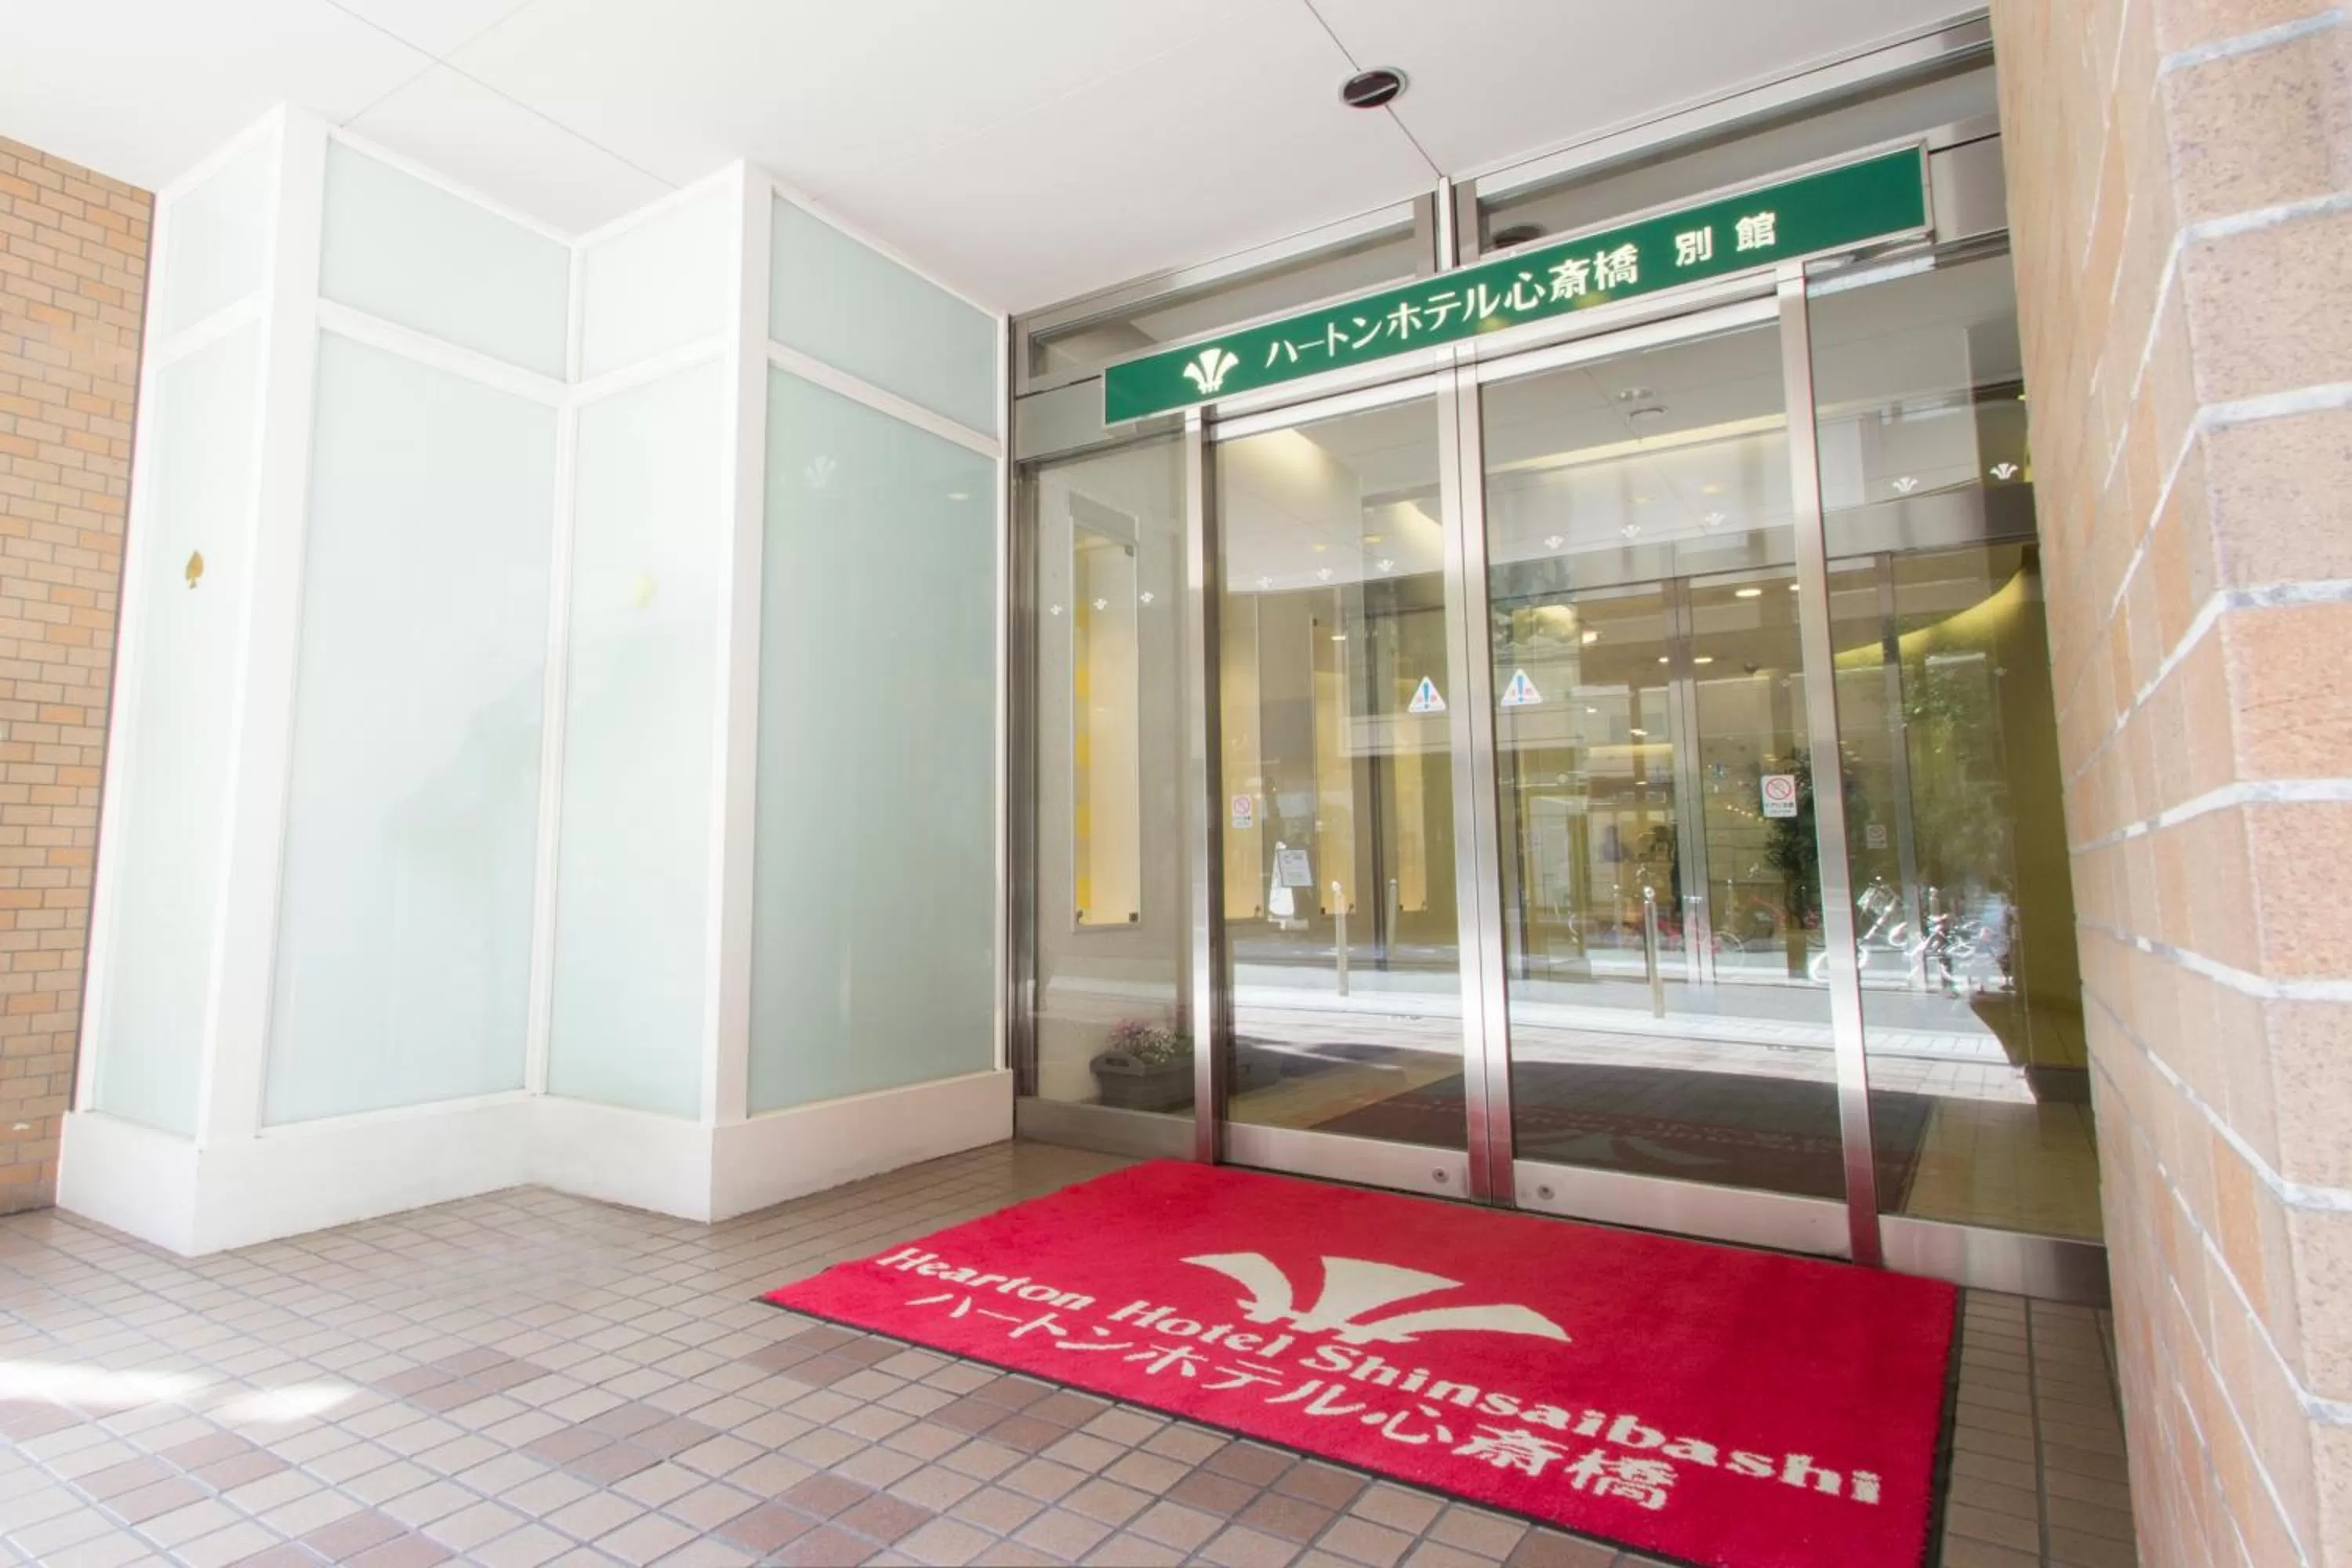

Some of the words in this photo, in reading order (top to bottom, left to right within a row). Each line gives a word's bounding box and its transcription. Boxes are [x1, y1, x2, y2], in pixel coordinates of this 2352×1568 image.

[1265, 244, 1639, 368] ハートンホテル心斎橋
[1675, 212, 1777, 267] 別館
[877, 1247, 1096, 1311] Hearton
[1106, 1300, 1295, 1358] Hotel
[1298, 1345, 1882, 1505] Shinsaibashi
[904, 1294, 1679, 1511] ハートンホテル心斎橋
